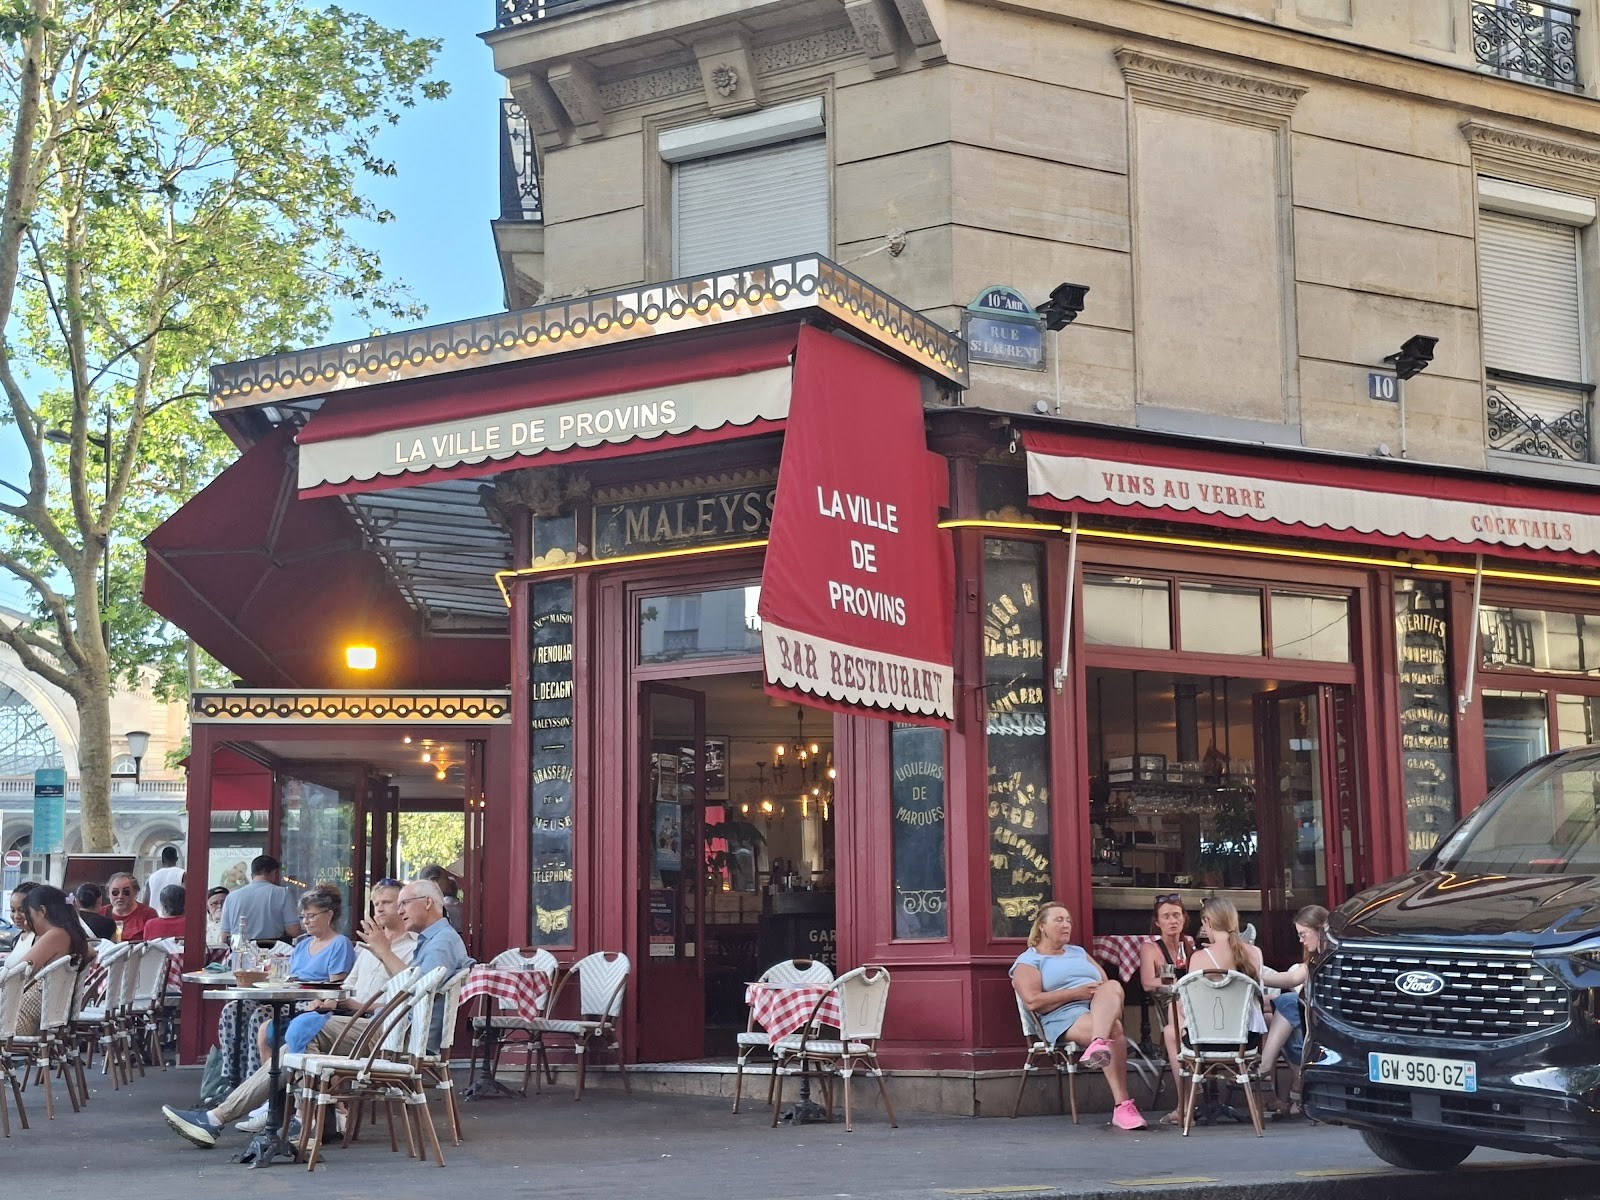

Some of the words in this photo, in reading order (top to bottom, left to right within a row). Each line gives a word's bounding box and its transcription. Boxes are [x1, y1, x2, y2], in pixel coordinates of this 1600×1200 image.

[990, 326, 1019, 340] RUE
[983, 342, 1039, 359] LAURENT
[1374, 375, 1394, 399] 10
[395, 438, 427, 464] LA
[431, 425, 500, 458] VILLE
[511, 419, 545, 446] DE
[559, 400, 677, 439] PROVINS
[1101, 471, 1156, 497] VINS
[1163, 479, 1190, 500] AU
[1197, 483, 1266, 509] VERRE
[817, 485, 845, 520] LA
[846, 493, 899, 534] VILLE
[1470, 515, 1573, 542] COCKTAILS
[850, 540, 877, 573] DE
[828, 581, 906, 626] PROVINS
[777, 635, 819, 681] BAR
[830, 651, 942, 703] RESTAURANT
[896, 761, 944, 782] LIQUEURS
[912, 786, 927, 801] DE
[896, 806, 945, 827] MARQUES
[1402, 974, 1436, 992] Ford
